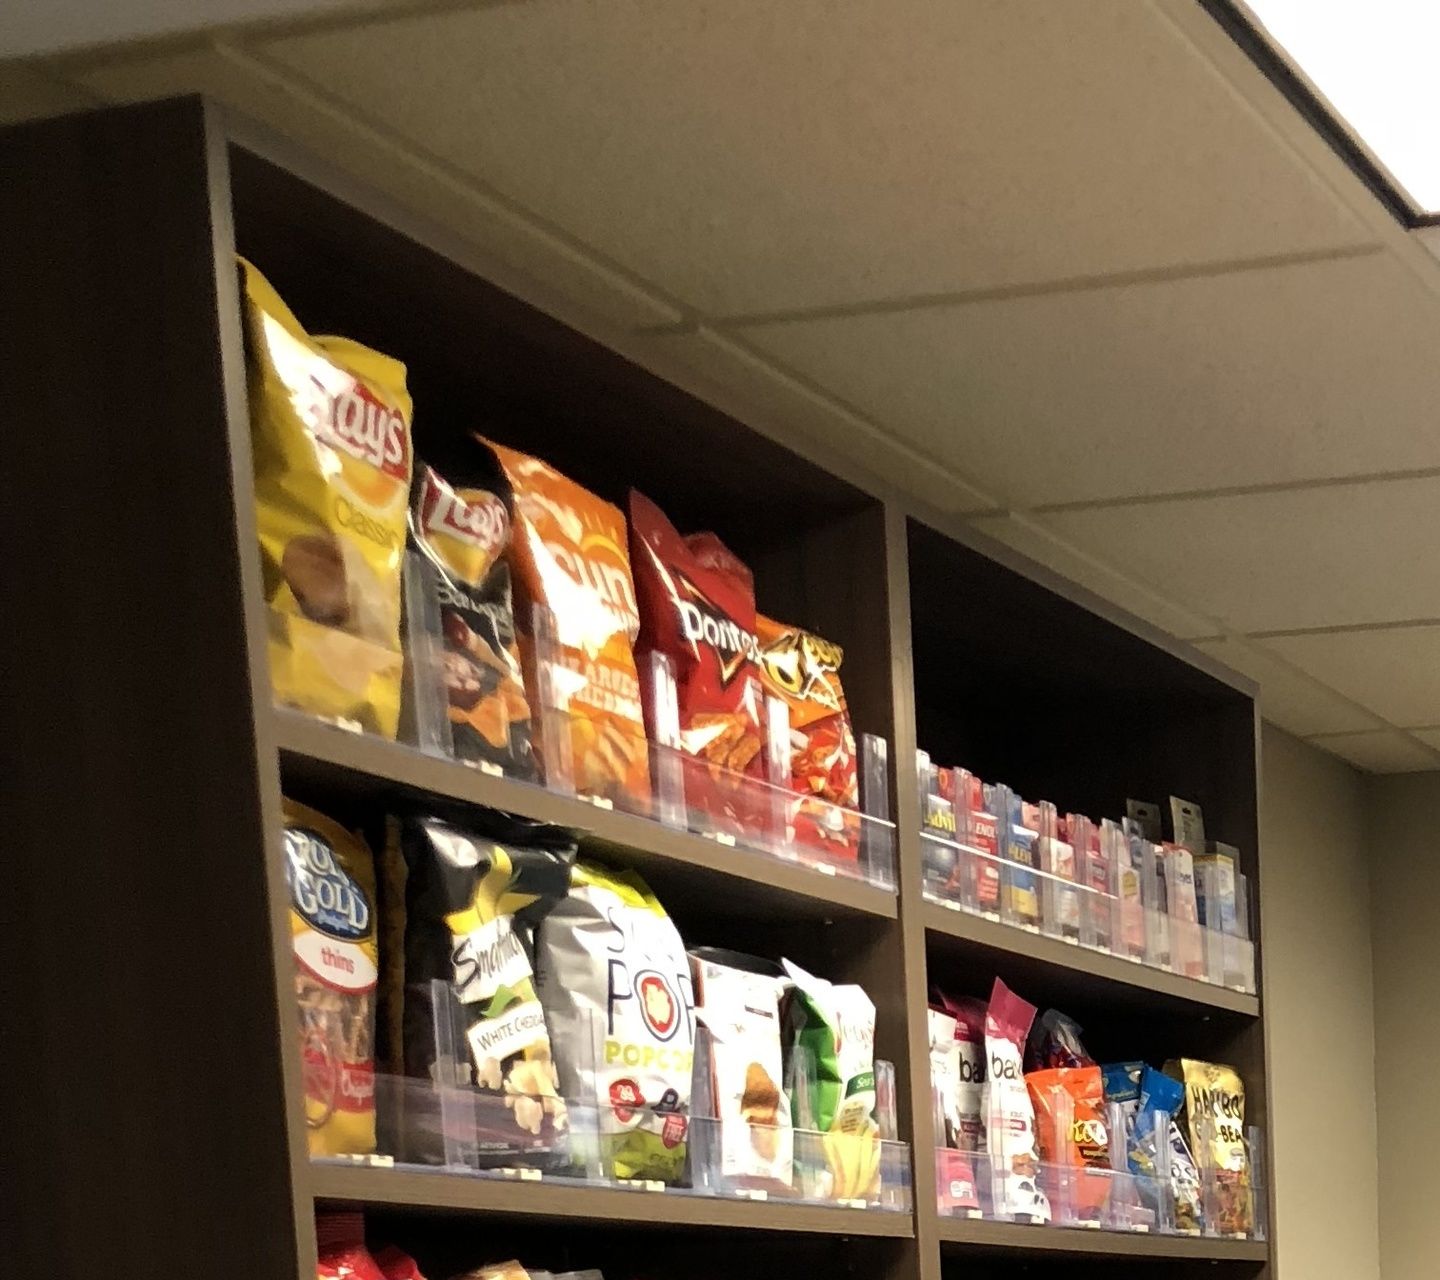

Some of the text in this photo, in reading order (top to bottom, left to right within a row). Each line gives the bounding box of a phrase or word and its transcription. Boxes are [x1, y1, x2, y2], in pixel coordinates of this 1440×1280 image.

[672, 597, 763, 665] Doritos
[293, 872, 369, 931] GOLD
[320, 945, 355, 976] thins
[477, 1020, 514, 1051] WHITE
